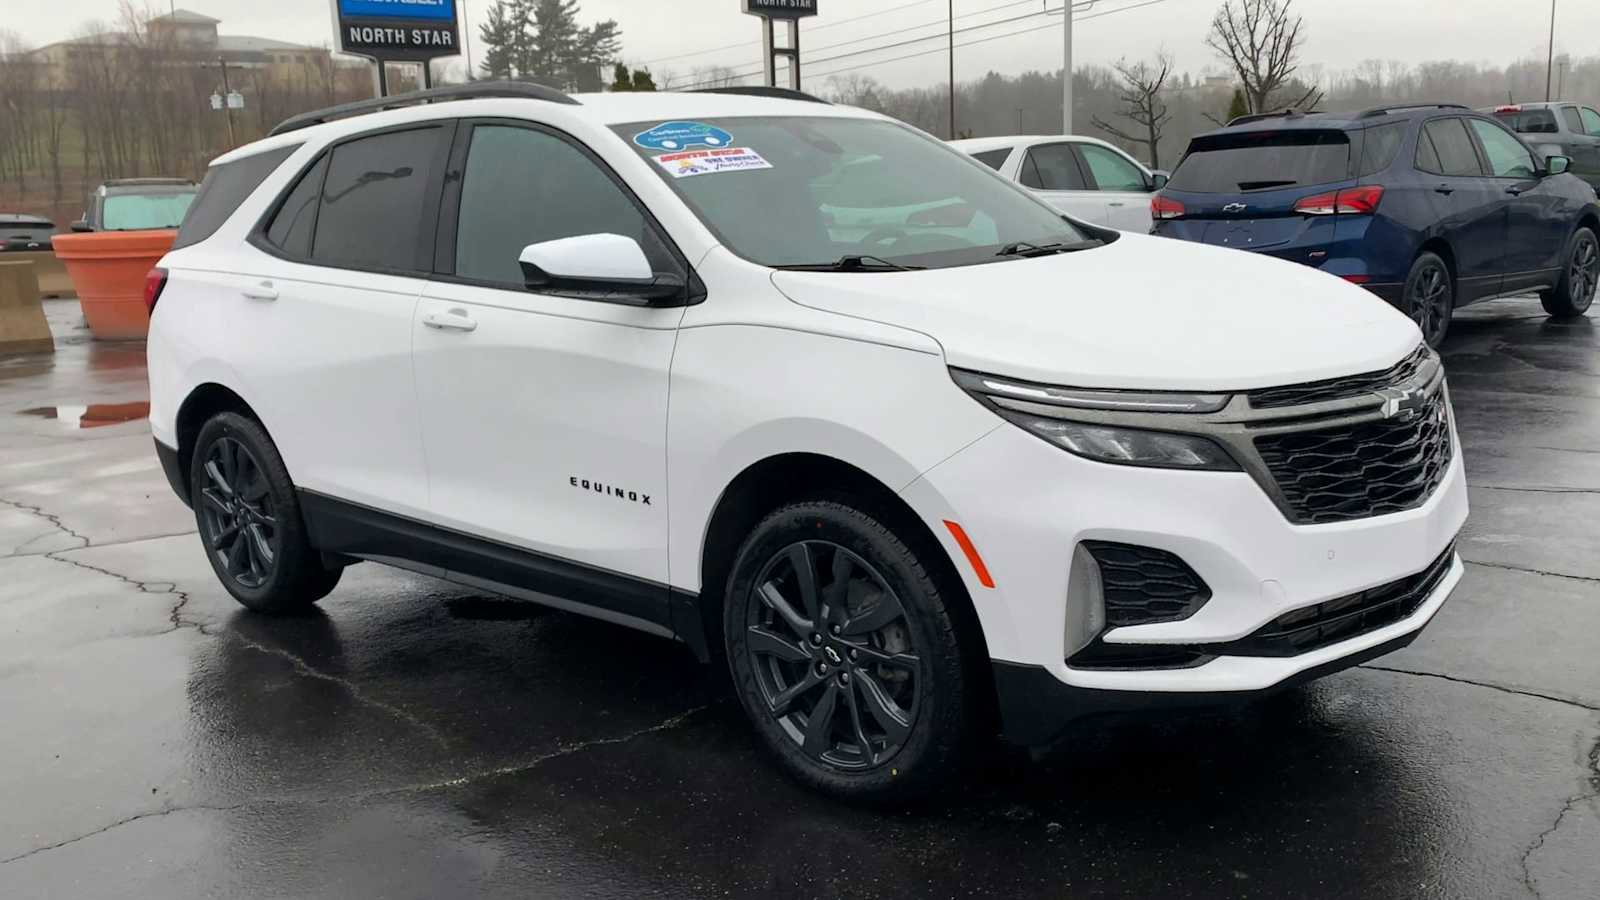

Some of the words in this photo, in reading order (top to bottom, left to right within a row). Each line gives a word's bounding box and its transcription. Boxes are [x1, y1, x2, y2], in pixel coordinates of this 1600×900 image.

[350, 27, 405, 43] NORTH
[412, 29, 452, 45] STAR
[569, 476, 651, 505] EQUINOX
